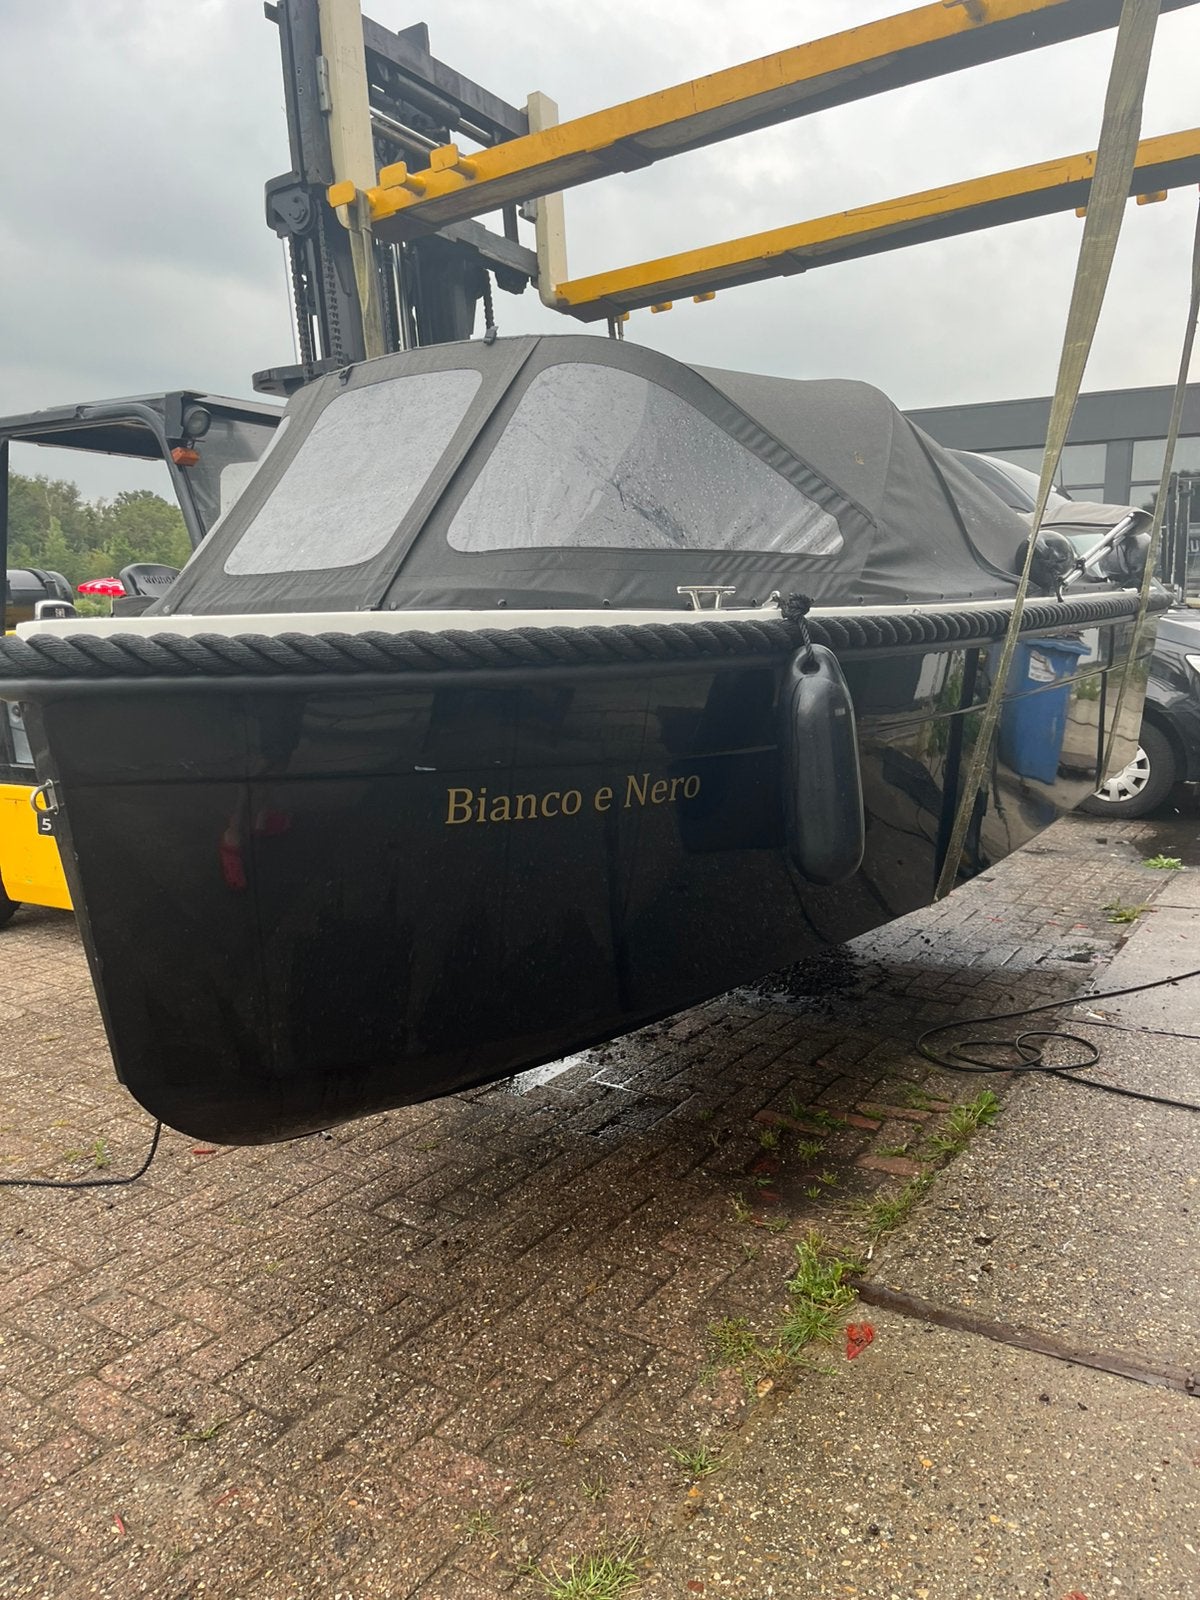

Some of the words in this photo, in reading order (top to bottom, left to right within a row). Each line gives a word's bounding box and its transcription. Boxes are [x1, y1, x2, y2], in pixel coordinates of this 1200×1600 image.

[445, 787, 582, 824] Bianco
[594, 786, 613, 811] e
[624, 772, 700, 808] Nero
[41, 817, 52, 831] 5
